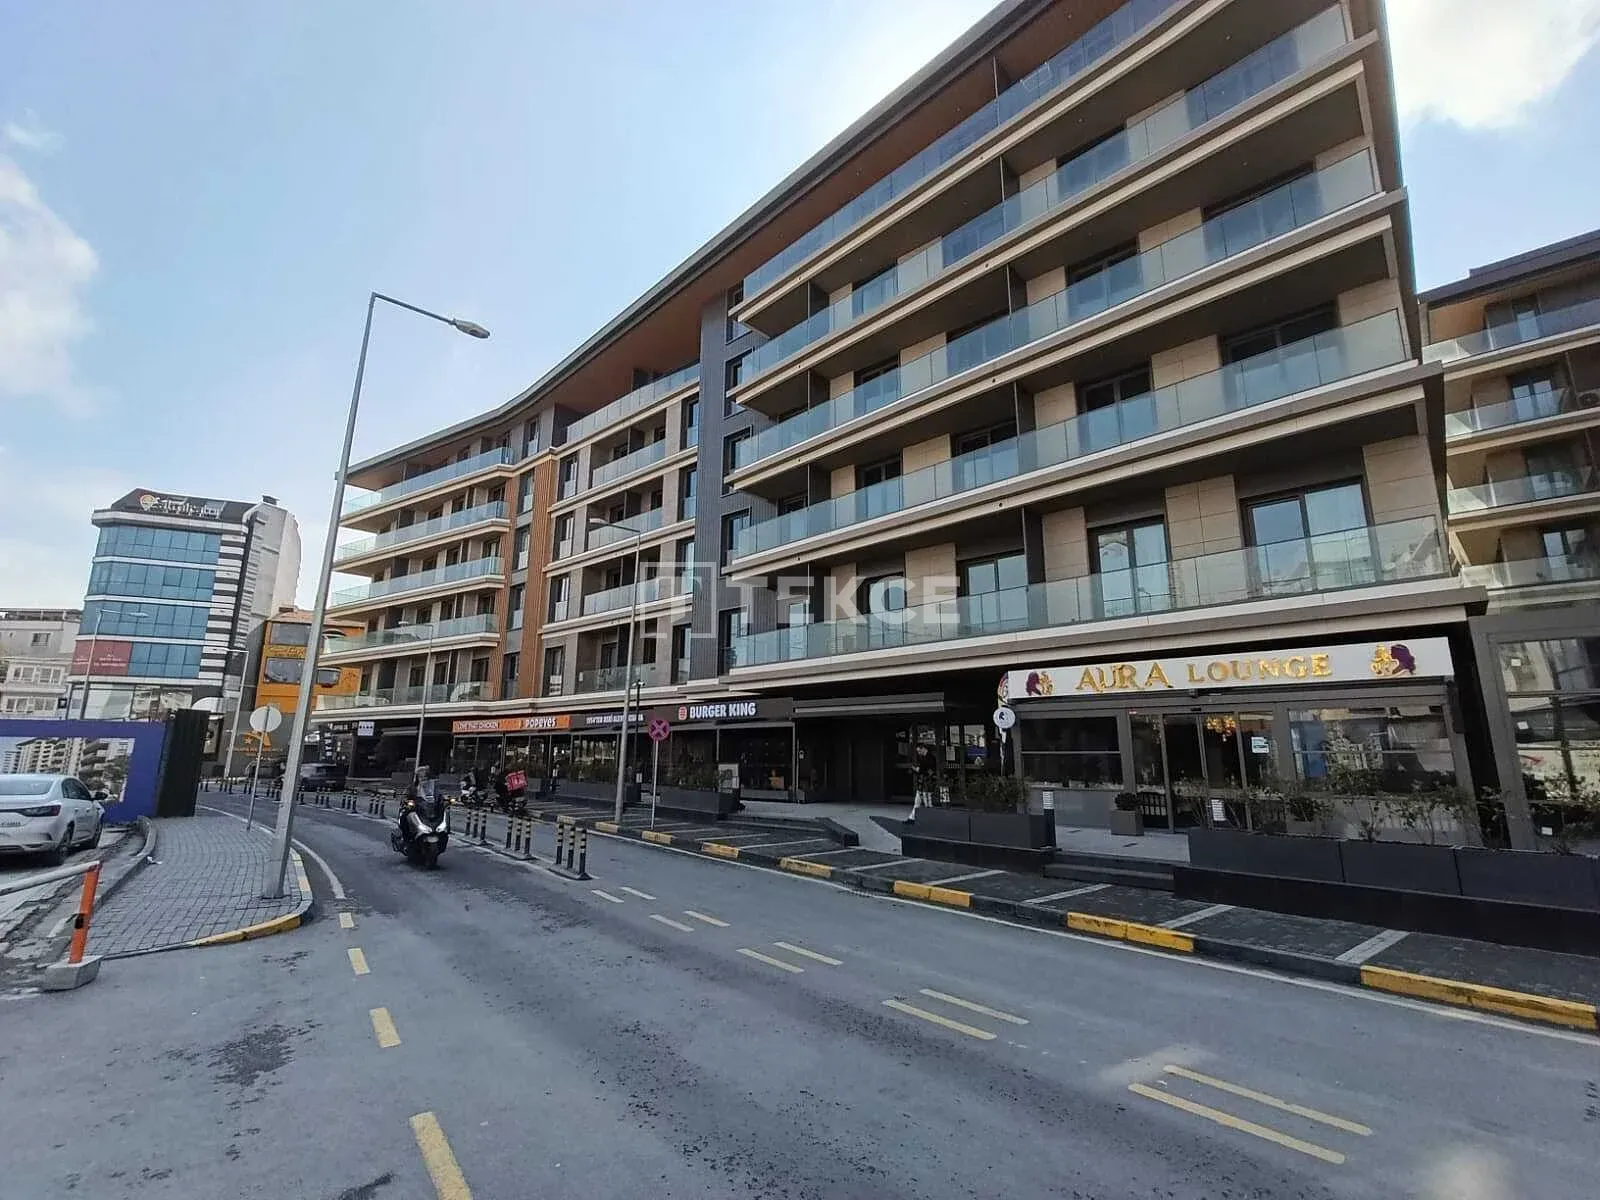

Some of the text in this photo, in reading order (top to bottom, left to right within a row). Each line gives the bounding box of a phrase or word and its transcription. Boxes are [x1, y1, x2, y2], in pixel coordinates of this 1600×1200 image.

[1075, 654, 1333, 692] AURA LOUNGE
[689, 702, 757, 719] BURGER KING
